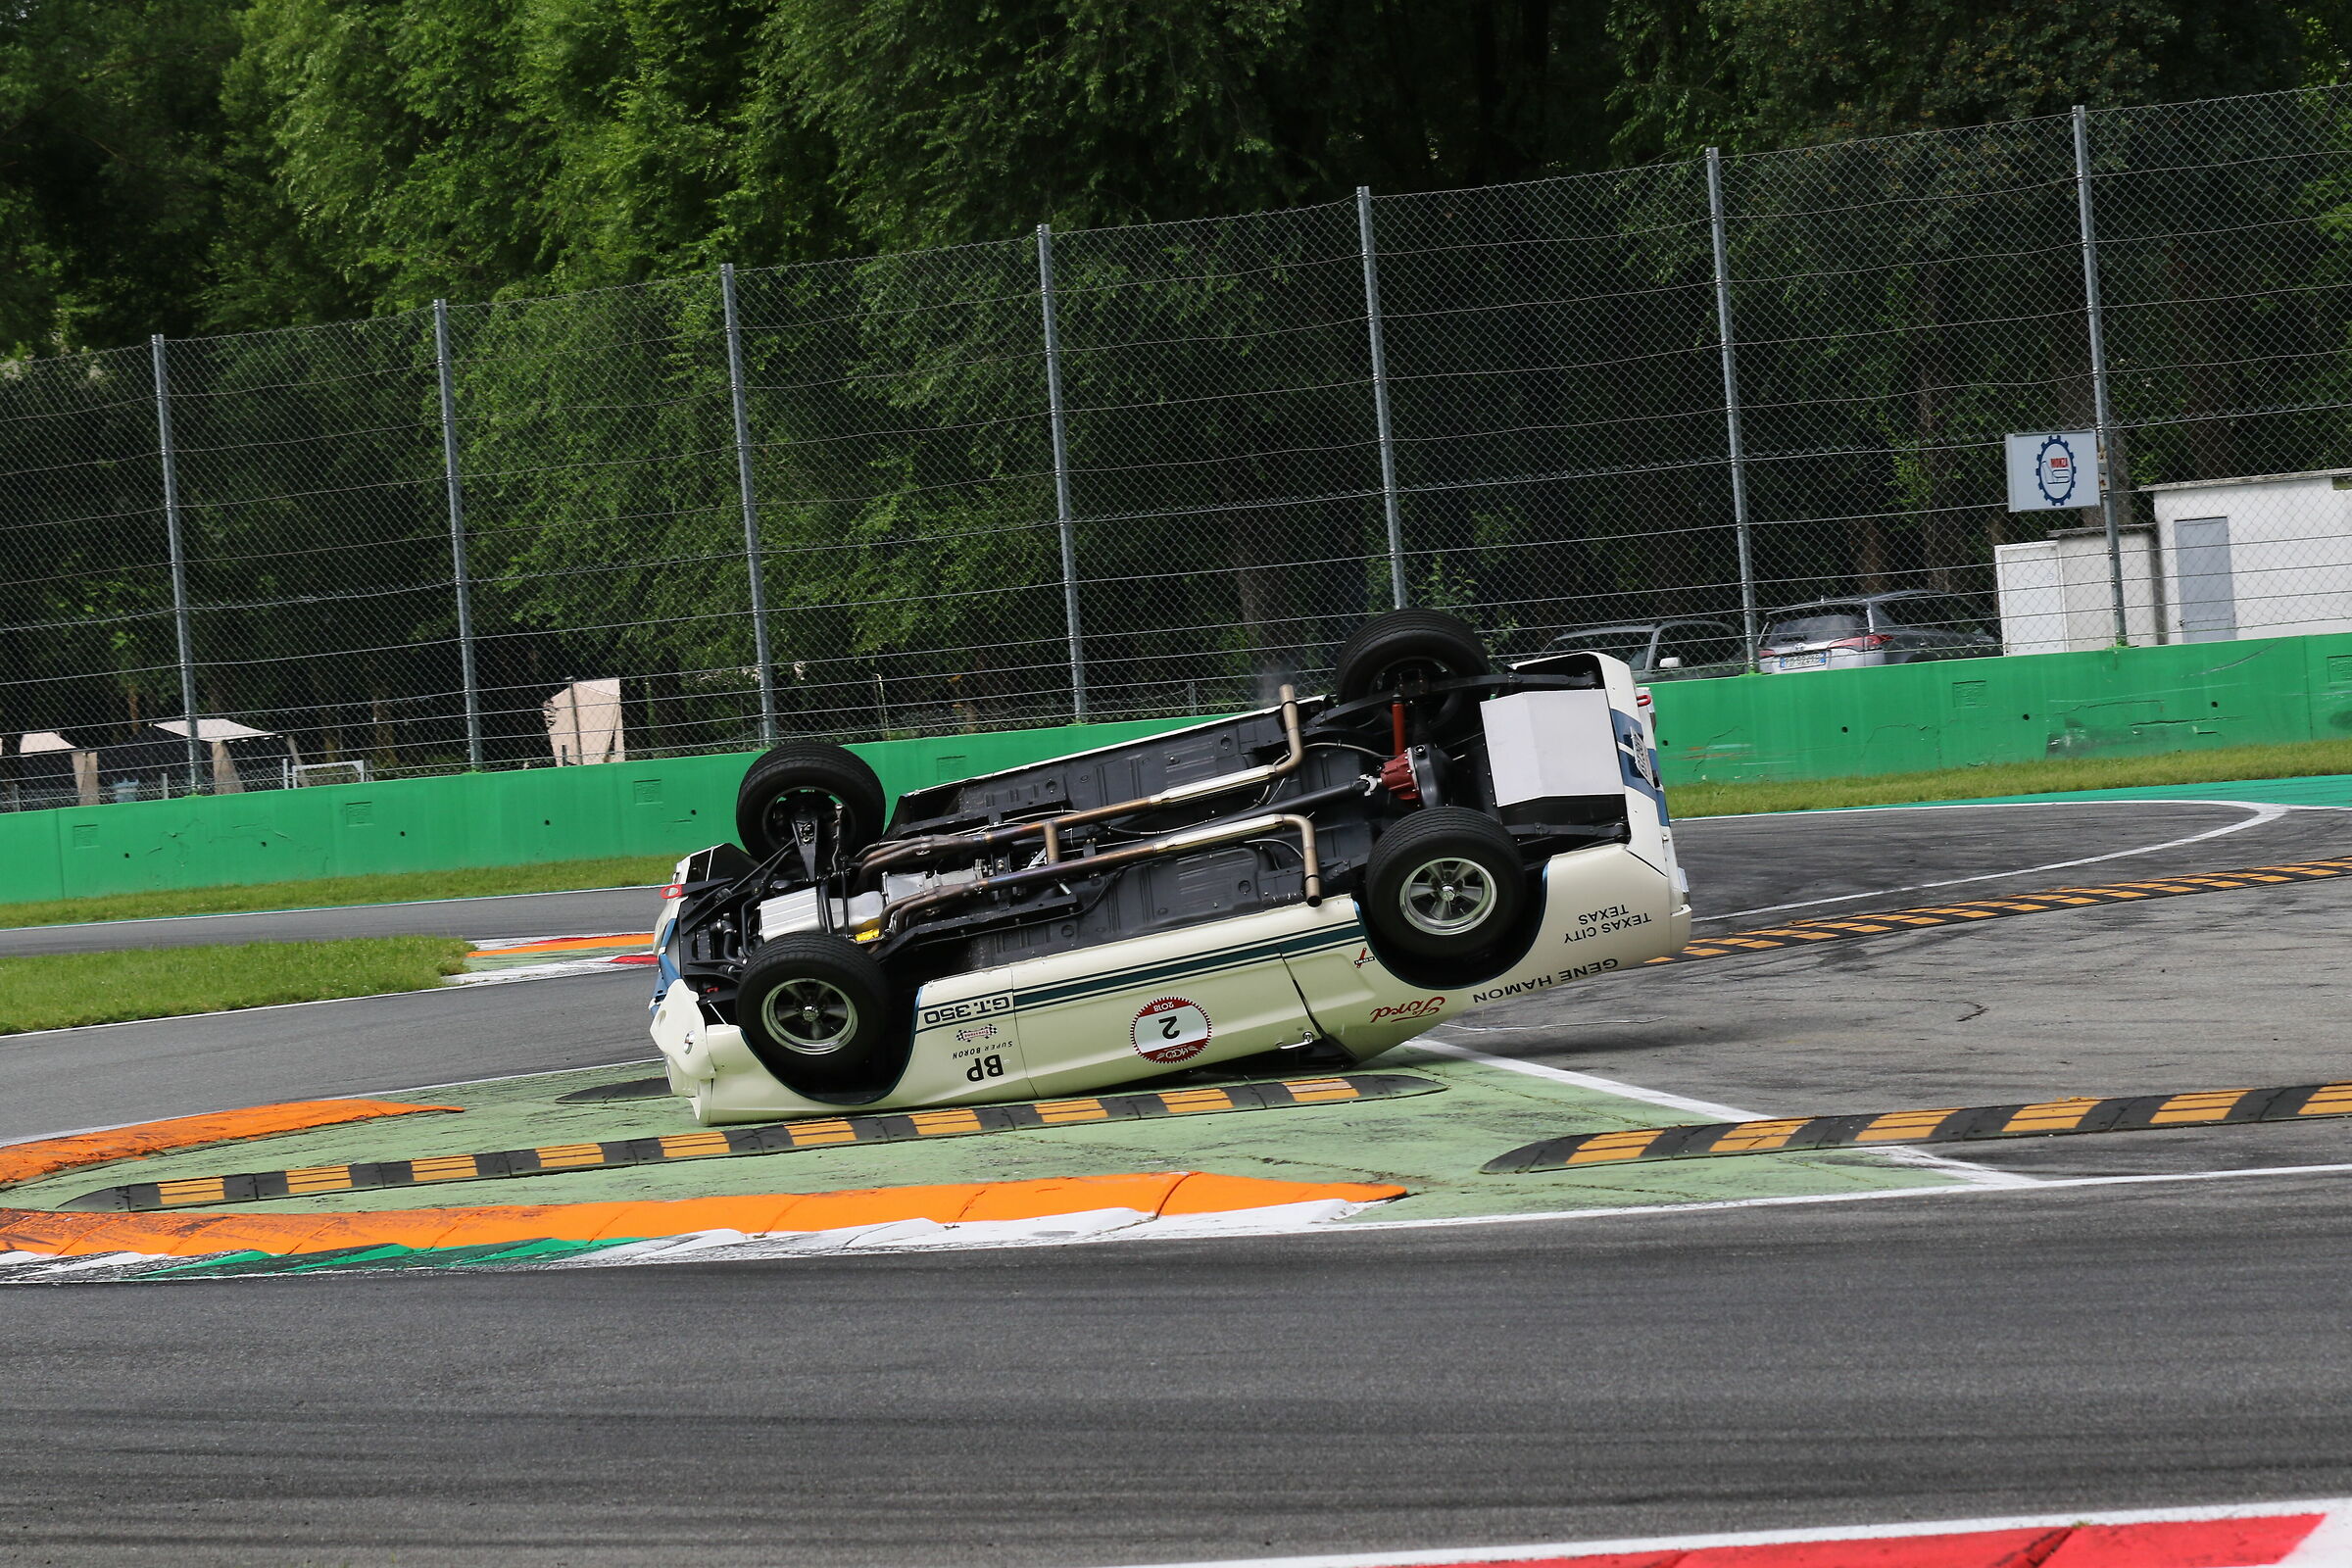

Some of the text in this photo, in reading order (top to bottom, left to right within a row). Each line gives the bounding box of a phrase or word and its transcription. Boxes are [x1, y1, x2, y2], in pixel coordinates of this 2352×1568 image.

[1578, 904, 1630, 925] TEXAS
[1563, 911, 1651, 945] TEXAS CITY
[1472, 957, 1618, 1004] GENE HAMON
[923, 997, 1009, 1024] G.T. 350
[1152, 1001, 1174, 1012] 2018
[1369, 997, 1446, 1023] Ford
[1158, 1015, 1181, 1040] 2
[952, 1041, 1013, 1059] SUPER BORON
[966, 1054, 1004, 1082] BP
